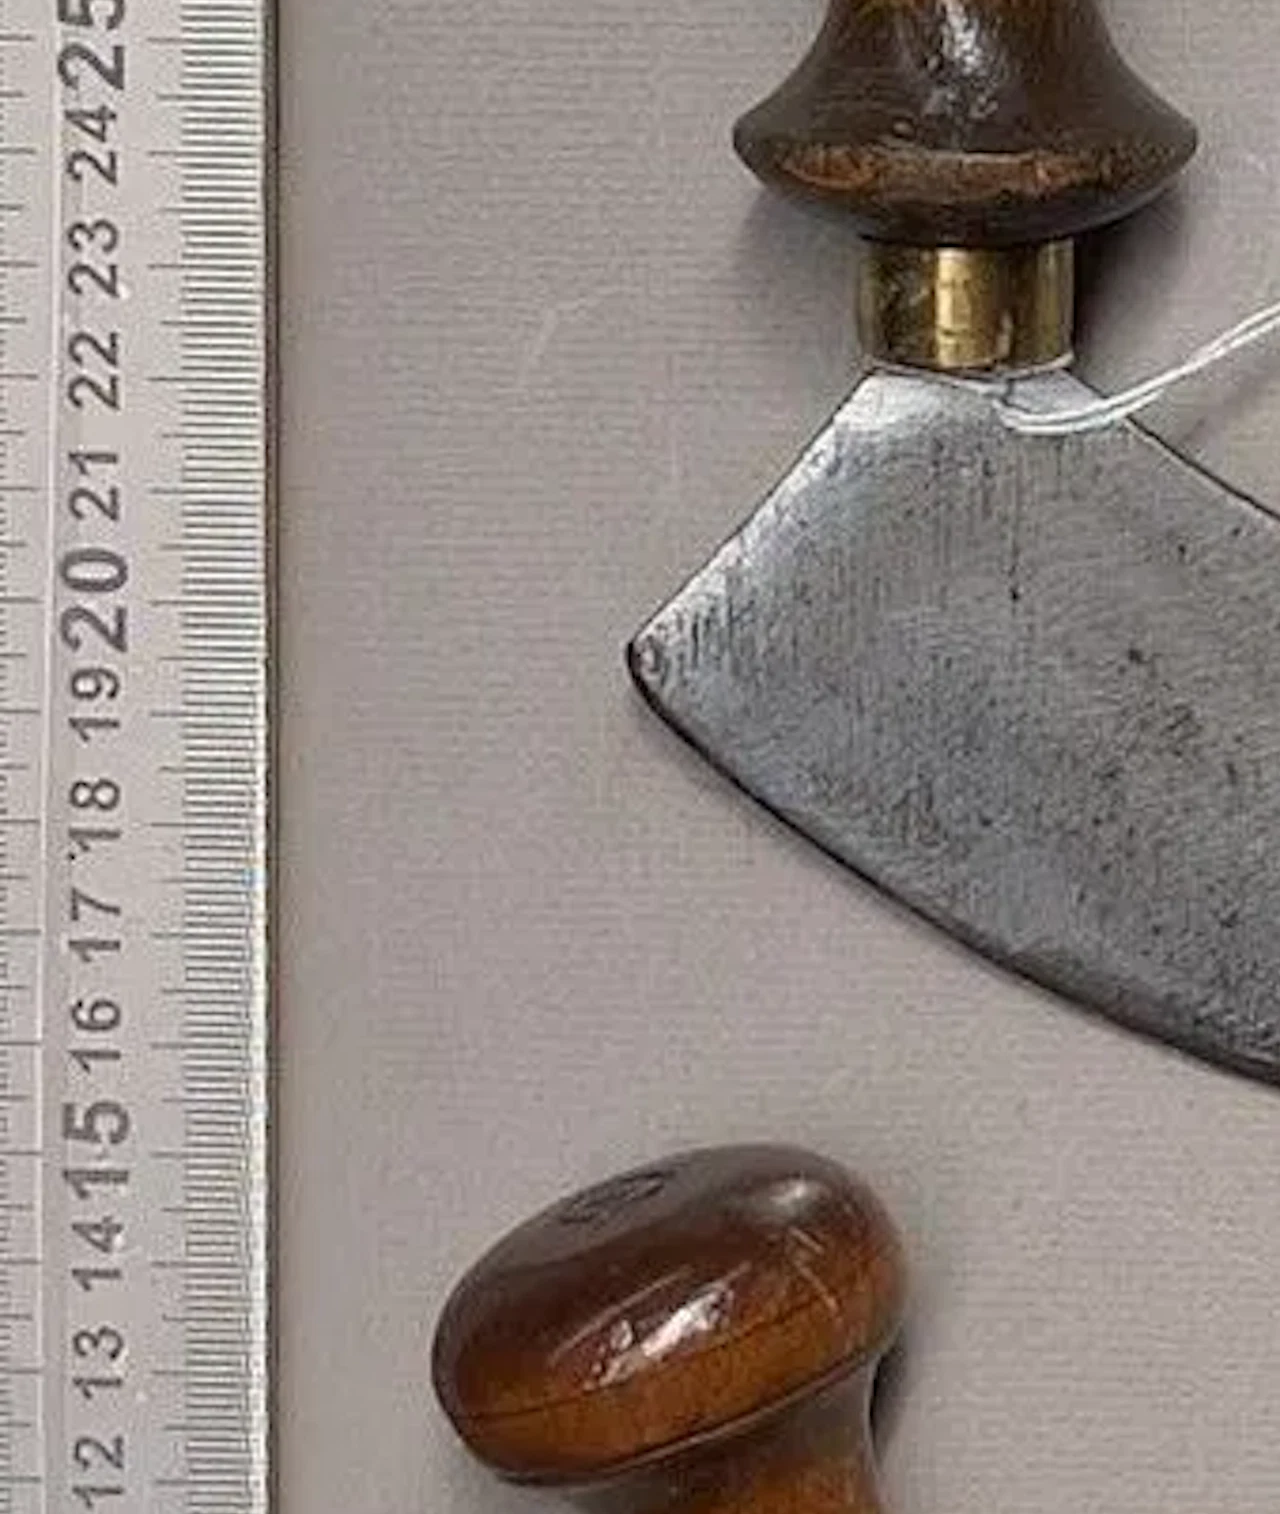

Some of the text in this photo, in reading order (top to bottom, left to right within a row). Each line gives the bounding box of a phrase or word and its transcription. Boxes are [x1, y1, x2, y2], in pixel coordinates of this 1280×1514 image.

[63, 103, 119, 188] 24
[64, 218, 120, 299] 23
[65, 330, 121, 411] 22
[66, 449, 121, 523] 21
[55, 547, 129, 654] 20
[67, 666, 121, 743] 19
[66, 777, 123, 854] 18
[67, 886, 122, 964] 17
[66, 998, 123, 1075] 16
[60, 1100, 131, 1201] 15
[70, 1215, 124, 1293] 14
[71, 1325, 125, 1401] 13
[71, 1435, 126, 1511] 12
